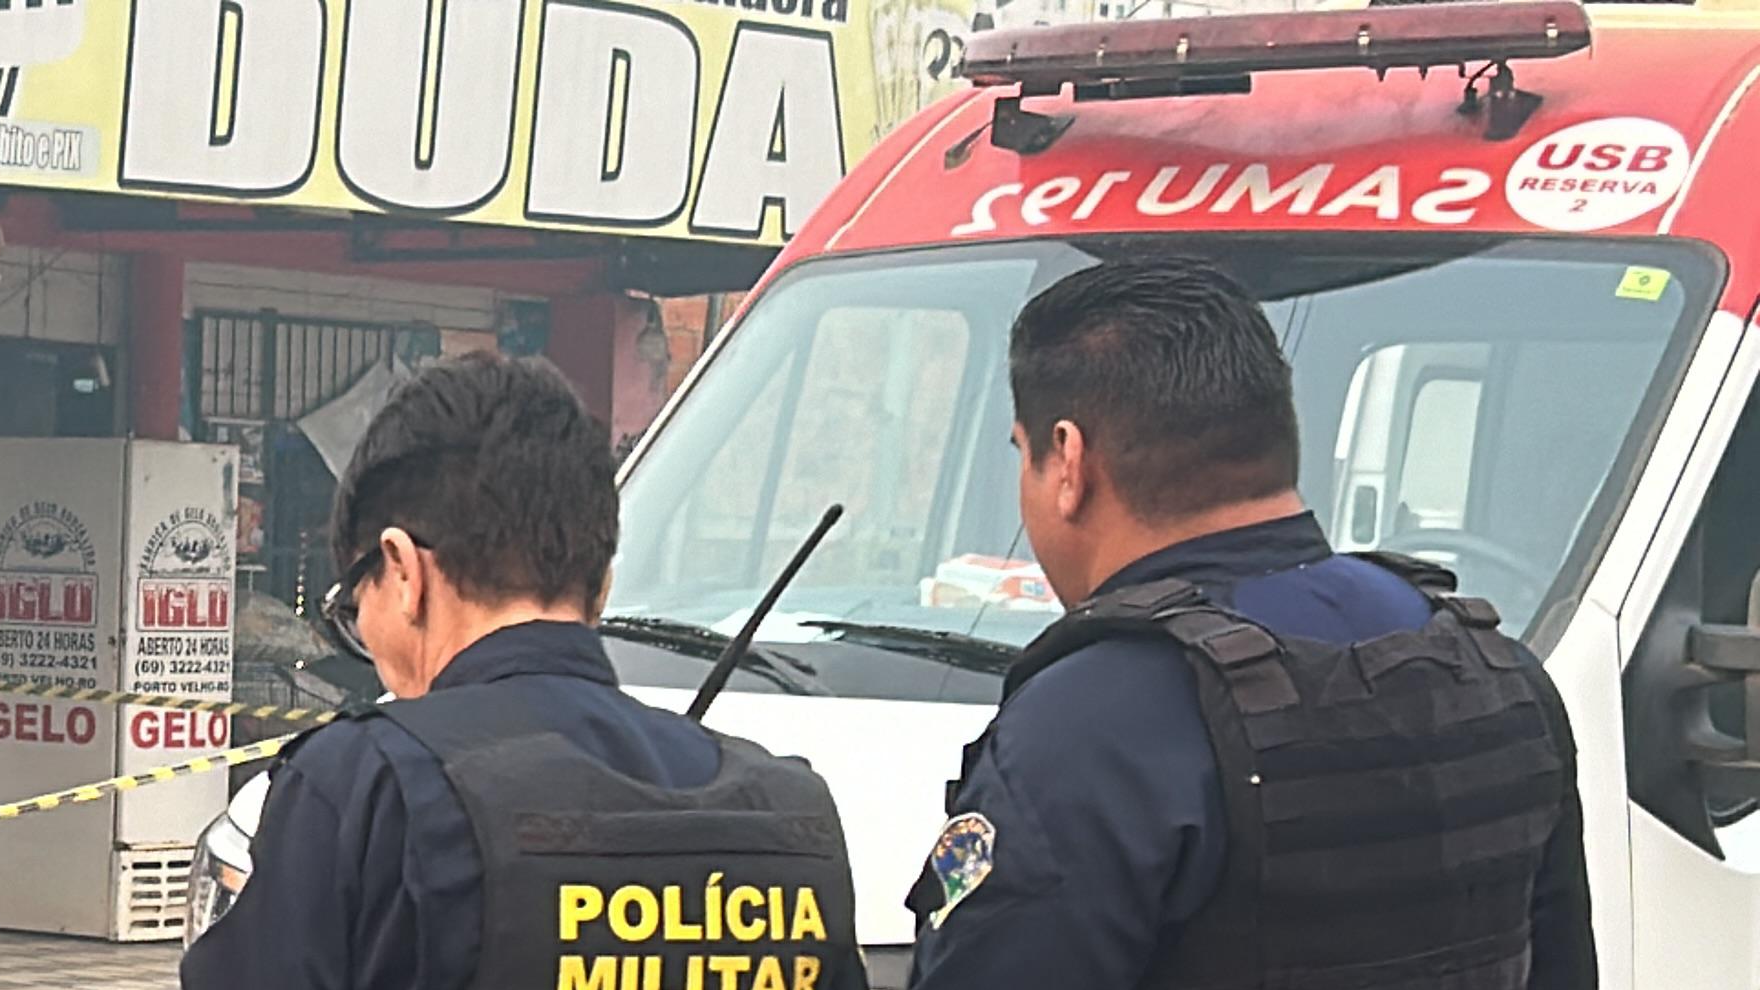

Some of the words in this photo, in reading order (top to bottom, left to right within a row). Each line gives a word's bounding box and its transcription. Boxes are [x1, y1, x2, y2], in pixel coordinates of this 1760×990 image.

[118, 0, 847, 240] DUDA
[37, 133, 49, 168] e
[51, 129, 83, 171] PIX
[1537, 144, 1673, 172] USB
[1519, 177, 1657, 195] RESERVA
[1569, 199, 1588, 213] 2
[37, 631, 51, 650] 24
[54, 631, 95, 652] HORAS
[137, 637, 183, 656] ABERTO
[19, 653, 97, 669] 3222-4321
[135, 660, 165, 677] (69)
[133, 681, 176, 693] PORTO
[130, 710, 228, 749] GELO
[558, 872, 827, 941] POLÍCIA
